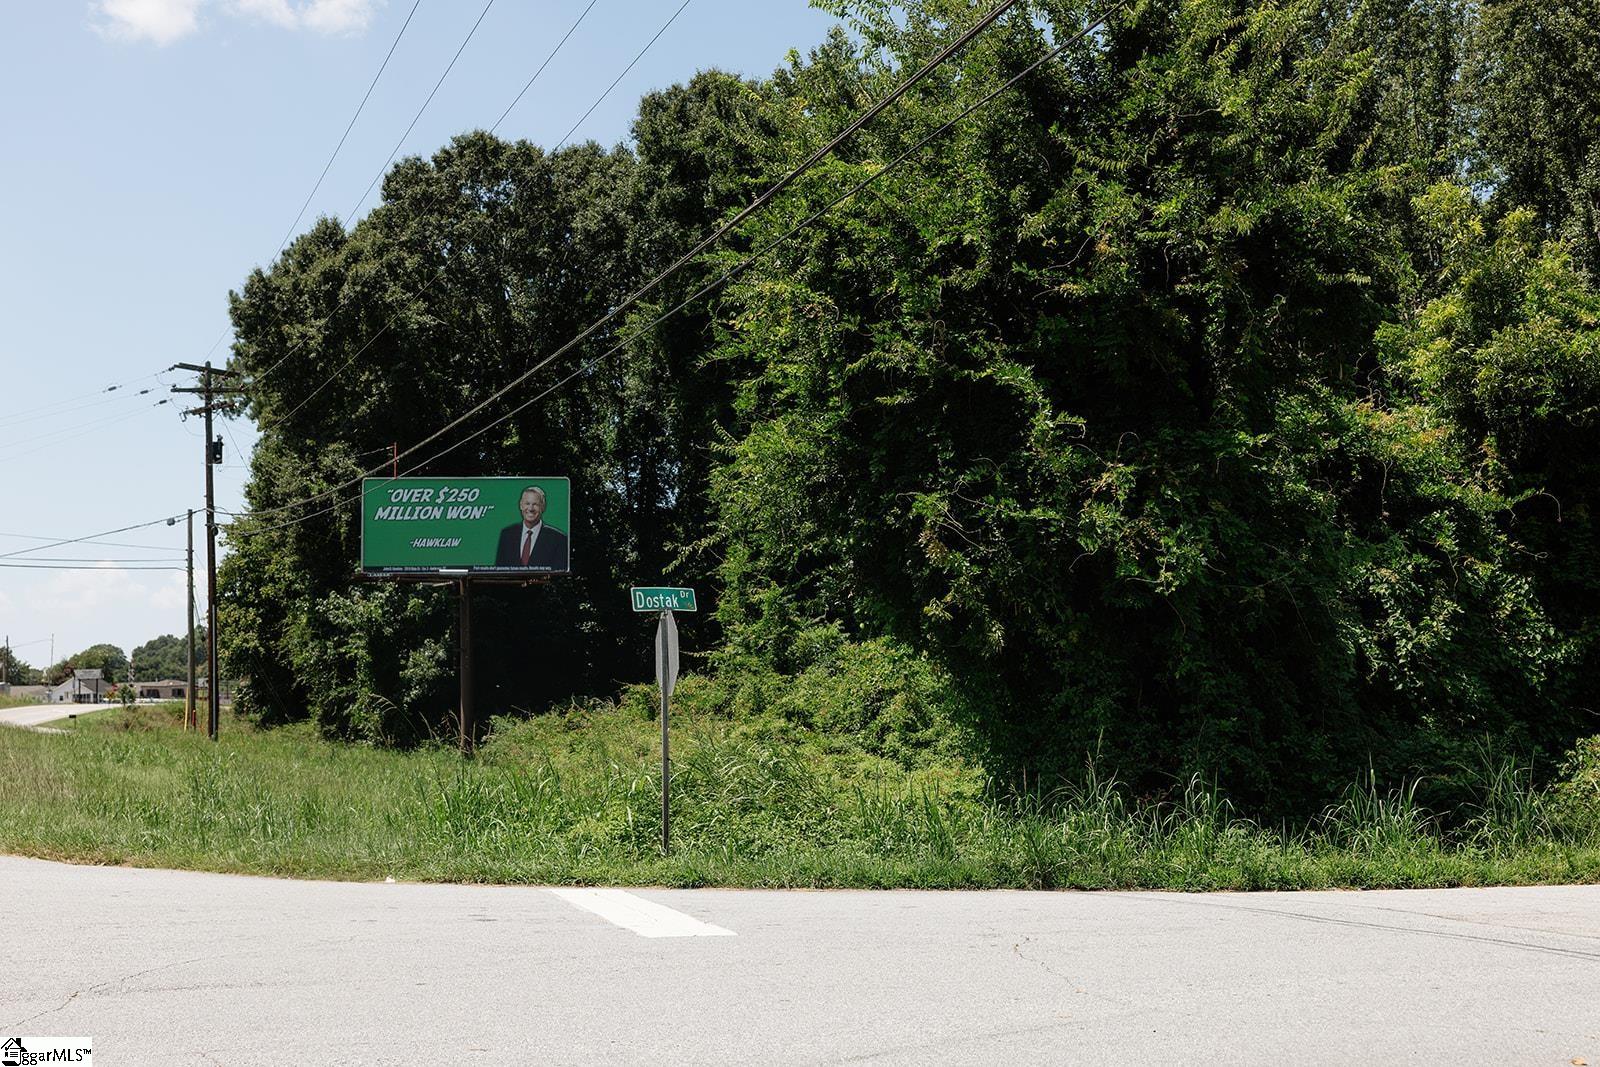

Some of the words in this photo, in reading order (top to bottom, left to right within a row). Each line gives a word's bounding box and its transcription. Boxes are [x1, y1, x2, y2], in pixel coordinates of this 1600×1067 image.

[435, 486, 480, 504] $250
[374, 505, 444, 520] MILLION
[410, 538, 461, 547] -HAWKLAW
[635, 591, 679, 608] Dostak
[680, 590, 689, 598] Dr
